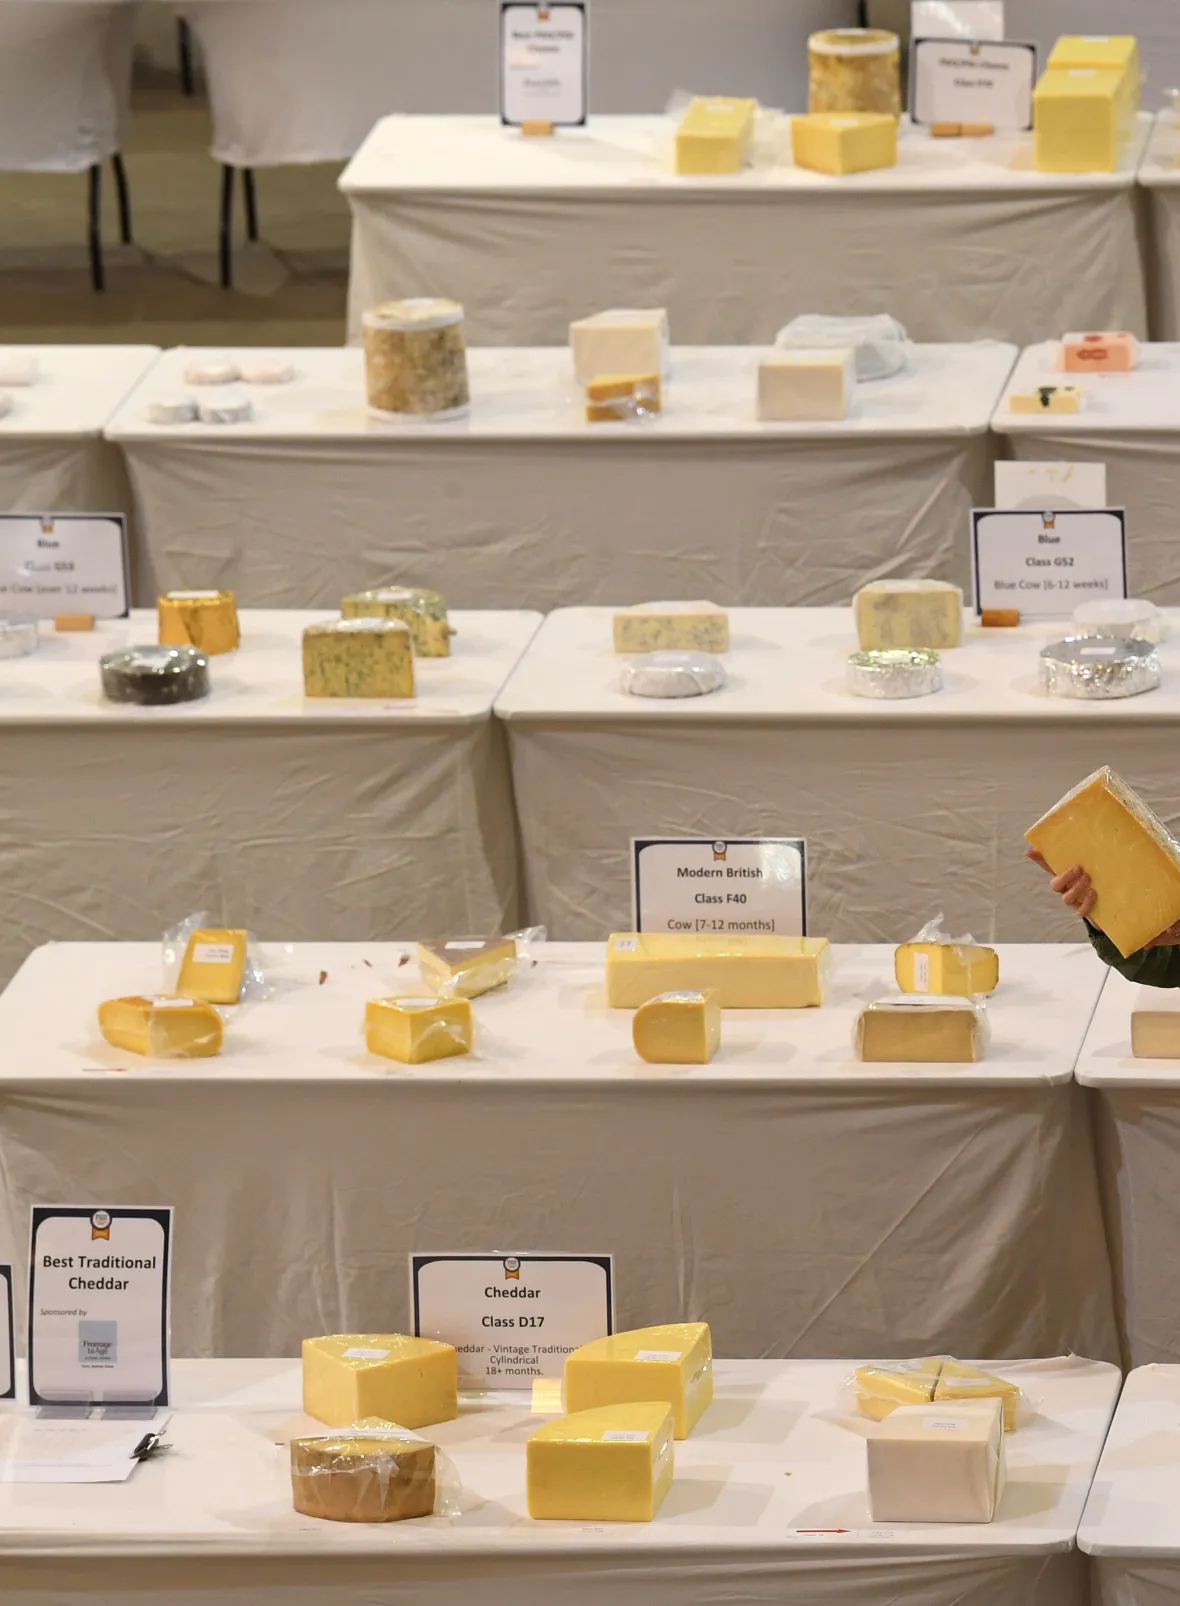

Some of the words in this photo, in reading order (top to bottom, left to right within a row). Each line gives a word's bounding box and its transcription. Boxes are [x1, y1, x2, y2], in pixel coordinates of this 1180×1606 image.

[1038, 535, 1061, 544] Blue
[1026, 557, 1052, 567] Class
[1054, 557, 1075, 567] G52
[994, 580, 1017, 590] Blue
[1019, 580, 1041, 591] Cow
[1044, 580, 1070, 592] [6-12
[1073, 579, 1109, 592] weeks]
[677, 867, 723, 878] Modern
[726, 867, 763, 878] British
[695, 893, 723, 904] Class
[726, 893, 747, 904] F40
[667, 919, 692, 930] Cow
[695, 919, 724, 932] [7-12
[728, 919, 775, 932] months]
[43, 1255, 74, 1268] Best
[78, 1256, 156, 1269] Traditional
[68, 1277, 129, 1290] Cheddar
[484, 1287, 541, 1298] Cheddar
[40, 1308, 77, 1317] Sponsored
[78, 1308, 88, 1317] by
[482, 1316, 515, 1328] Class
[519, 1317, 545, 1328] D17
[493, 1345, 530, 1355] Vintage
[532, 1345, 582, 1353] Tradition
[490, 1356, 539, 1366] Cylindrical
[486, 1367, 502, 1375] 18+
[505, 1366, 544, 1376] months.
